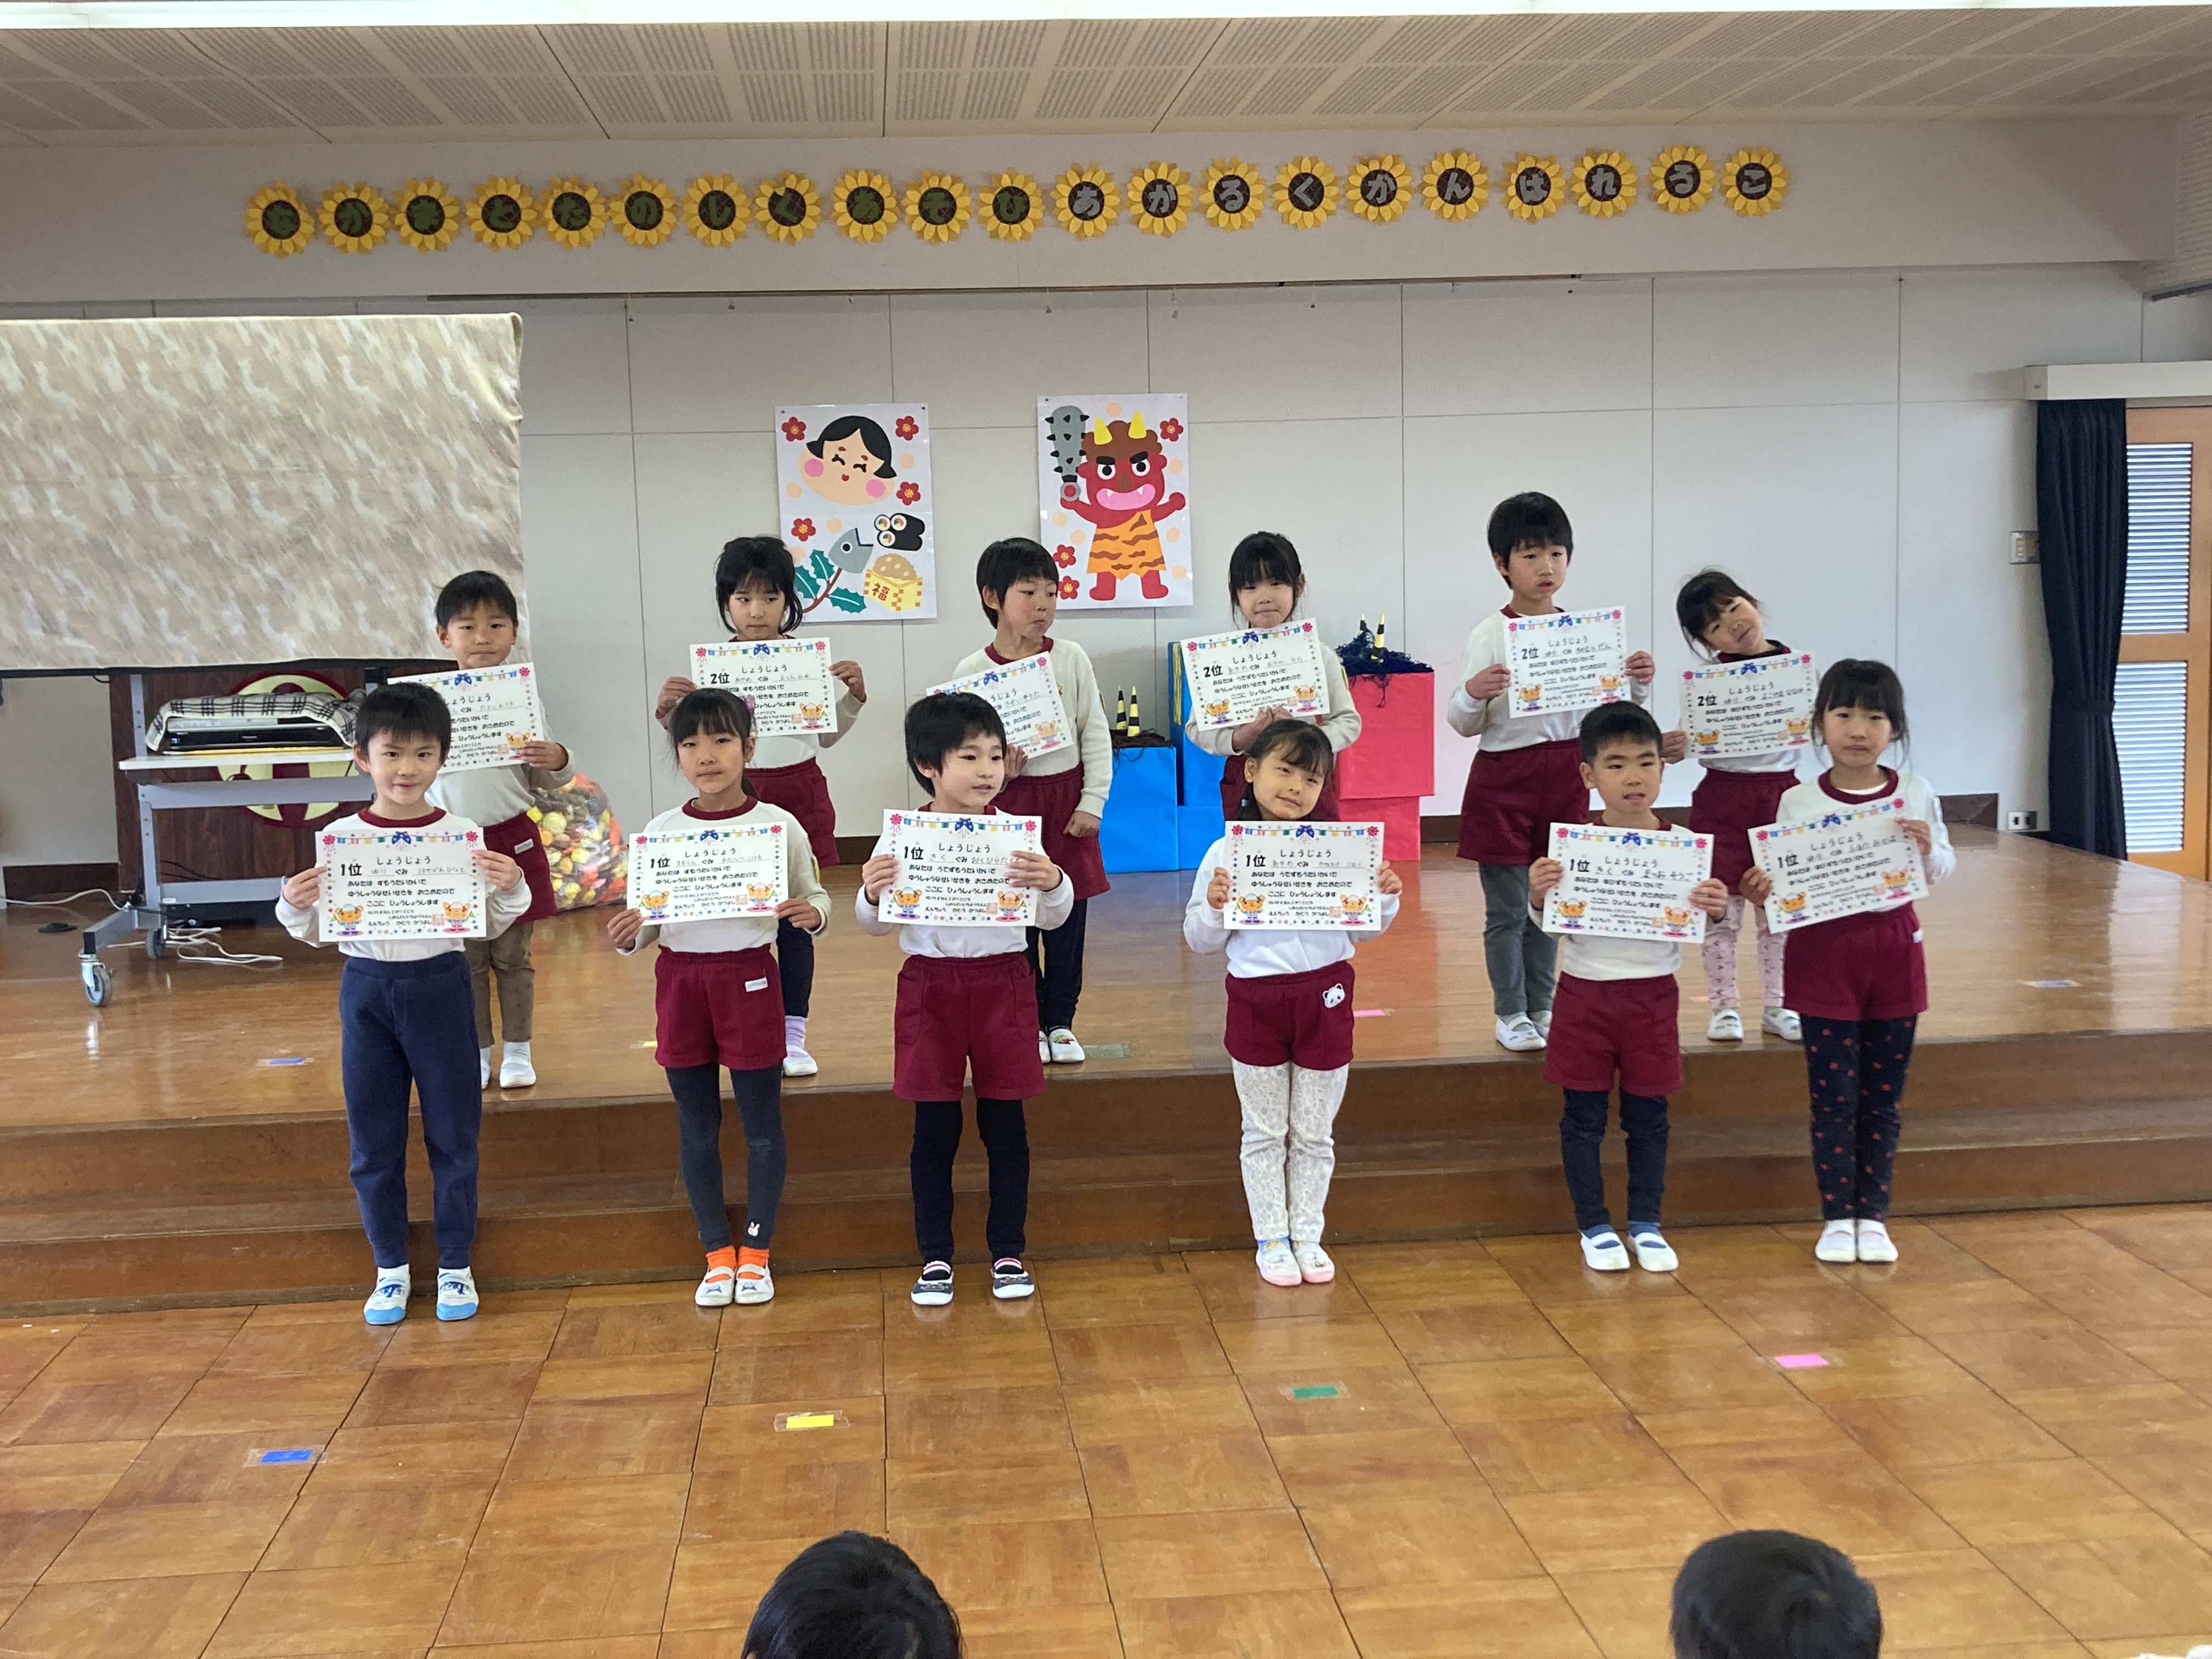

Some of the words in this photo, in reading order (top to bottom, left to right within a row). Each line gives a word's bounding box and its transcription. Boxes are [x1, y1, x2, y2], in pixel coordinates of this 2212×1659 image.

[872, 582, 890, 601] 福
[1233, 650, 1277, 664] しょうじょう
[742, 664, 787, 674] しょうじょう
[1203, 664, 1223, 677] 2位
[710, 673, 730, 684] 2位
[1729, 681, 1773, 694] しょうじょう
[1697, 695, 1717, 707] 2位
[685, 847, 736, 857] しょうじょう
[904, 846, 924, 860] 1位
[939, 843, 990, 853] しょうじょう
[1280, 849, 1331, 858] しょうじょう
[377, 855, 431, 865] しょうじょう
[650, 857, 670, 868] 1位
[1246, 855, 1266, 867] 1位
[1570, 859, 1589, 872] 1位
[1605, 855, 1657, 868] しょうじょう
[341, 863, 362, 876] 1位
